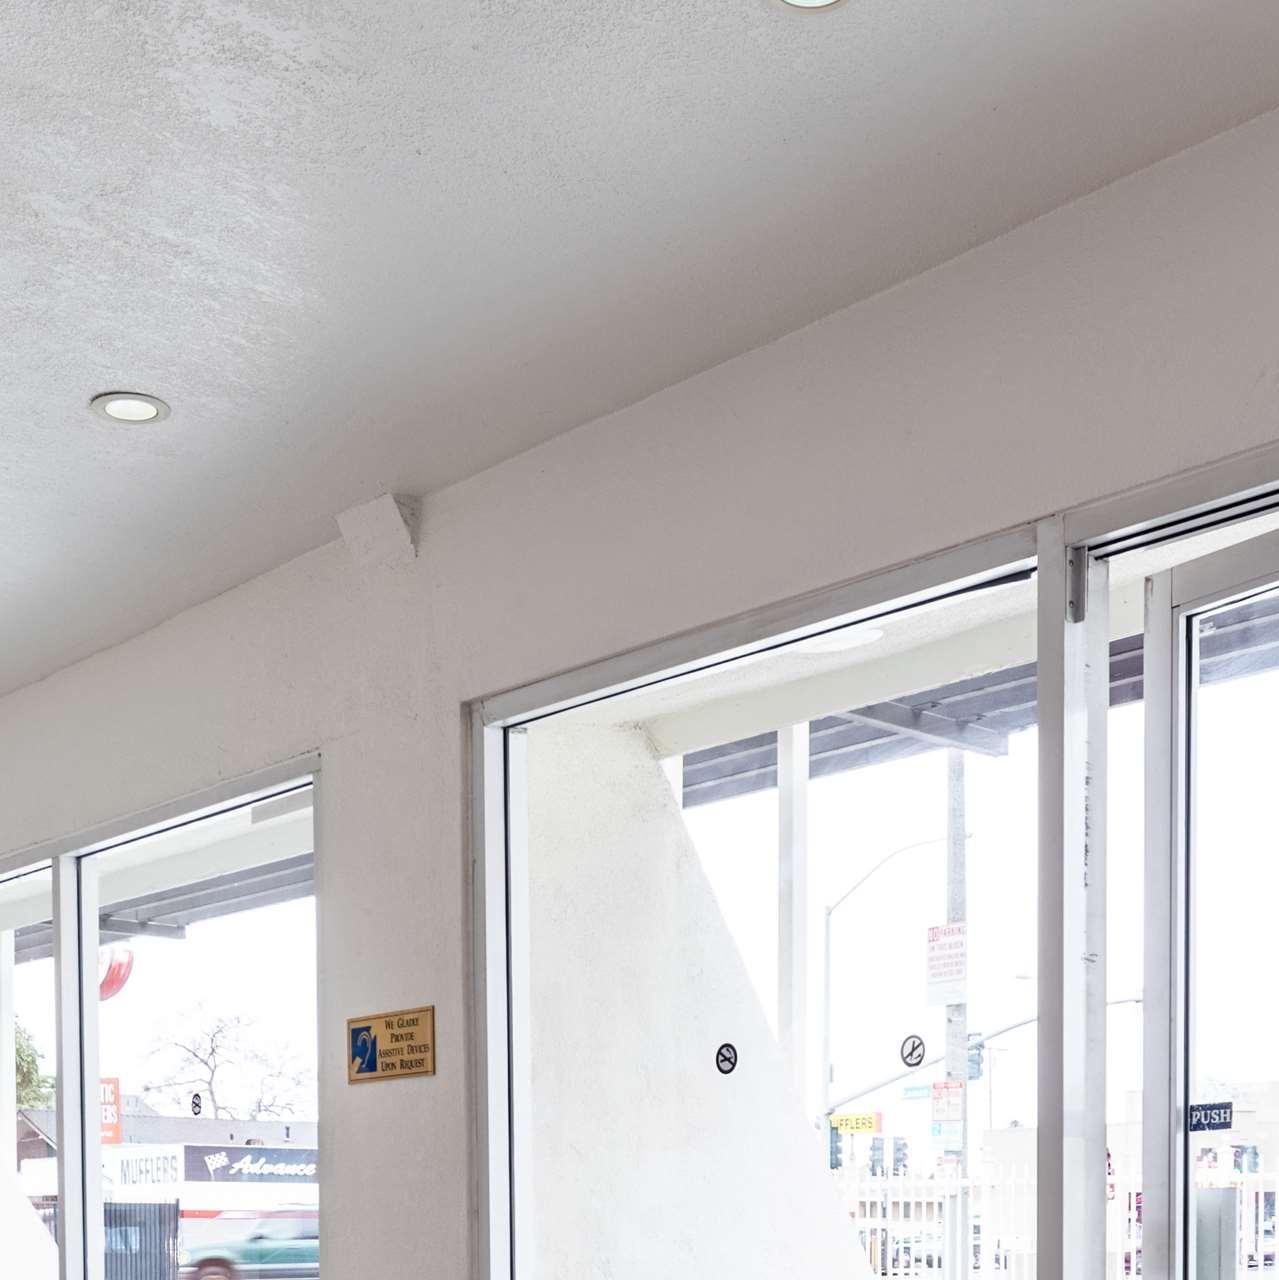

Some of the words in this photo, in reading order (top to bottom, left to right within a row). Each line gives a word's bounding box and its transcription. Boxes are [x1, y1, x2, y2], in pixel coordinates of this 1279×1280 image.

[1191, 1109, 1232, 1124] PUSH
[120, 1155, 178, 1185] MUFFLERS
[229, 1153, 317, 1177] Advance
